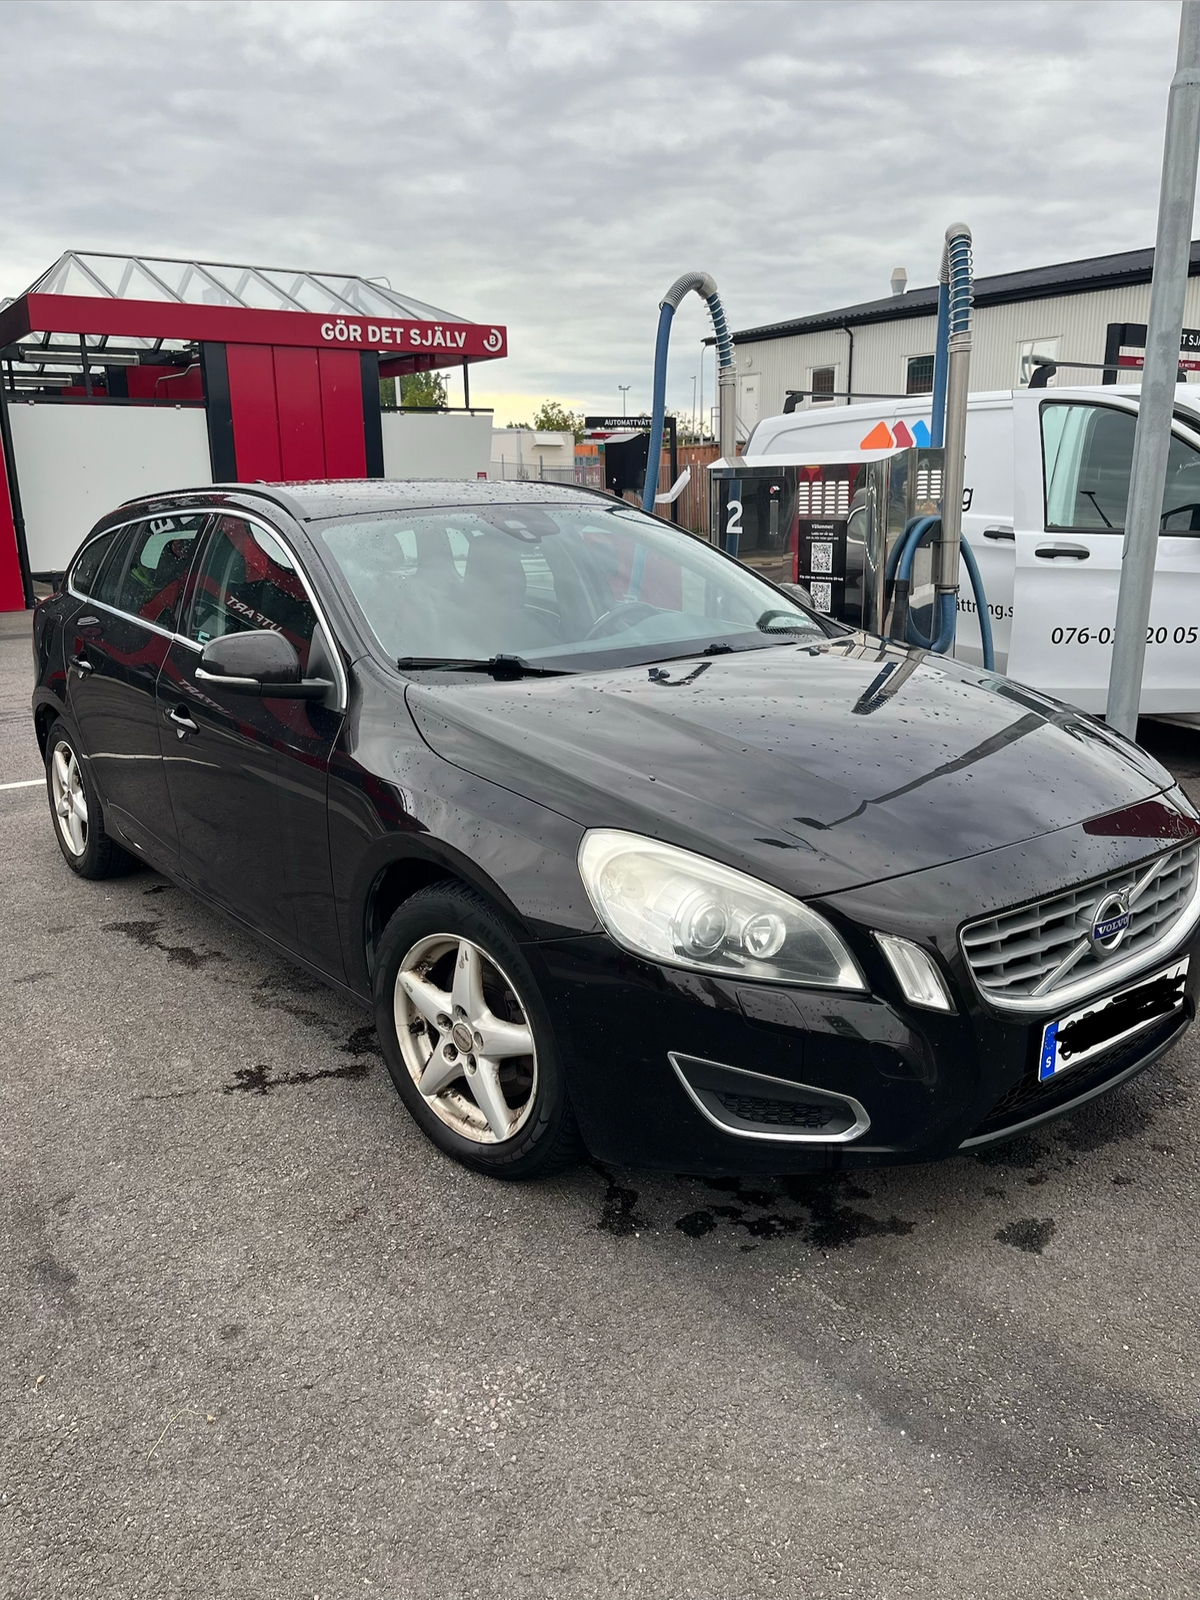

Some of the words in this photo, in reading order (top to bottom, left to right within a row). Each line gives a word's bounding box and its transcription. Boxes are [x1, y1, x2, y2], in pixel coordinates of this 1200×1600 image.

[321, 319, 362, 342] GÖR
[367, 325, 404, 344] DET
[409, 326, 466, 348] SJÄLV
[726, 500, 743, 534] 2
[1051, 627, 1115, 645] 076-0
[1173, 626, 1198, 644] 05
[1097, 916, 1128, 935] VOLVO
[1045, 1056, 1052, 1069] S
